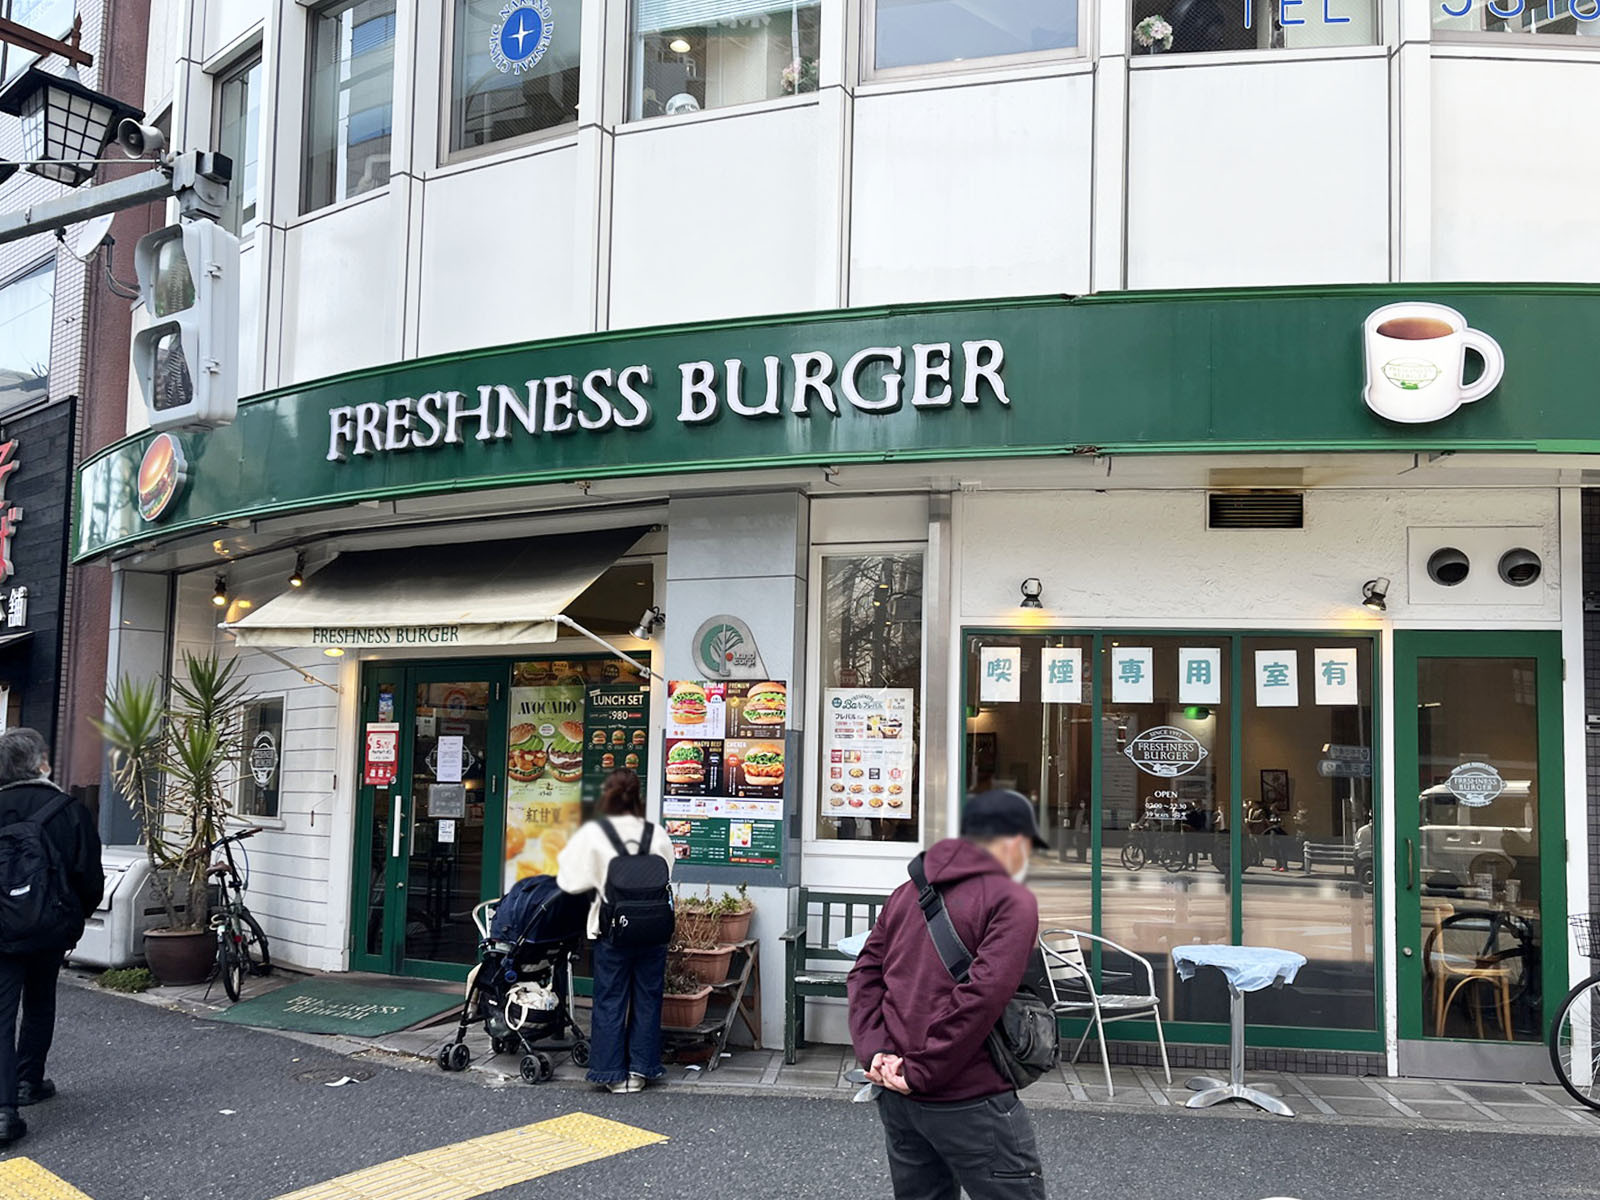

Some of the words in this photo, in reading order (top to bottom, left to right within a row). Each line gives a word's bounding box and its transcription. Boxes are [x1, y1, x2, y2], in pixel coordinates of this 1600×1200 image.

[489, 24, 511, 73] CLINIC
[513, 21, 554, 75] DENTAL
[327, 364, 653, 462] FRESHNESS
[677, 339, 1010, 423] BURGER
[312, 627, 391, 644] FRESHNESS
[396, 626, 459, 643] BURGER
[518, 700, 577, 715] AVOCADO
[593, 695, 625, 705] LUNCH
[627, 695, 644, 705] SET
[1138, 742, 1195, 753] FRESHNESS
[1144, 751, 1190, 761] BURGER
[1154, 790, 1179, 798] OPEN
